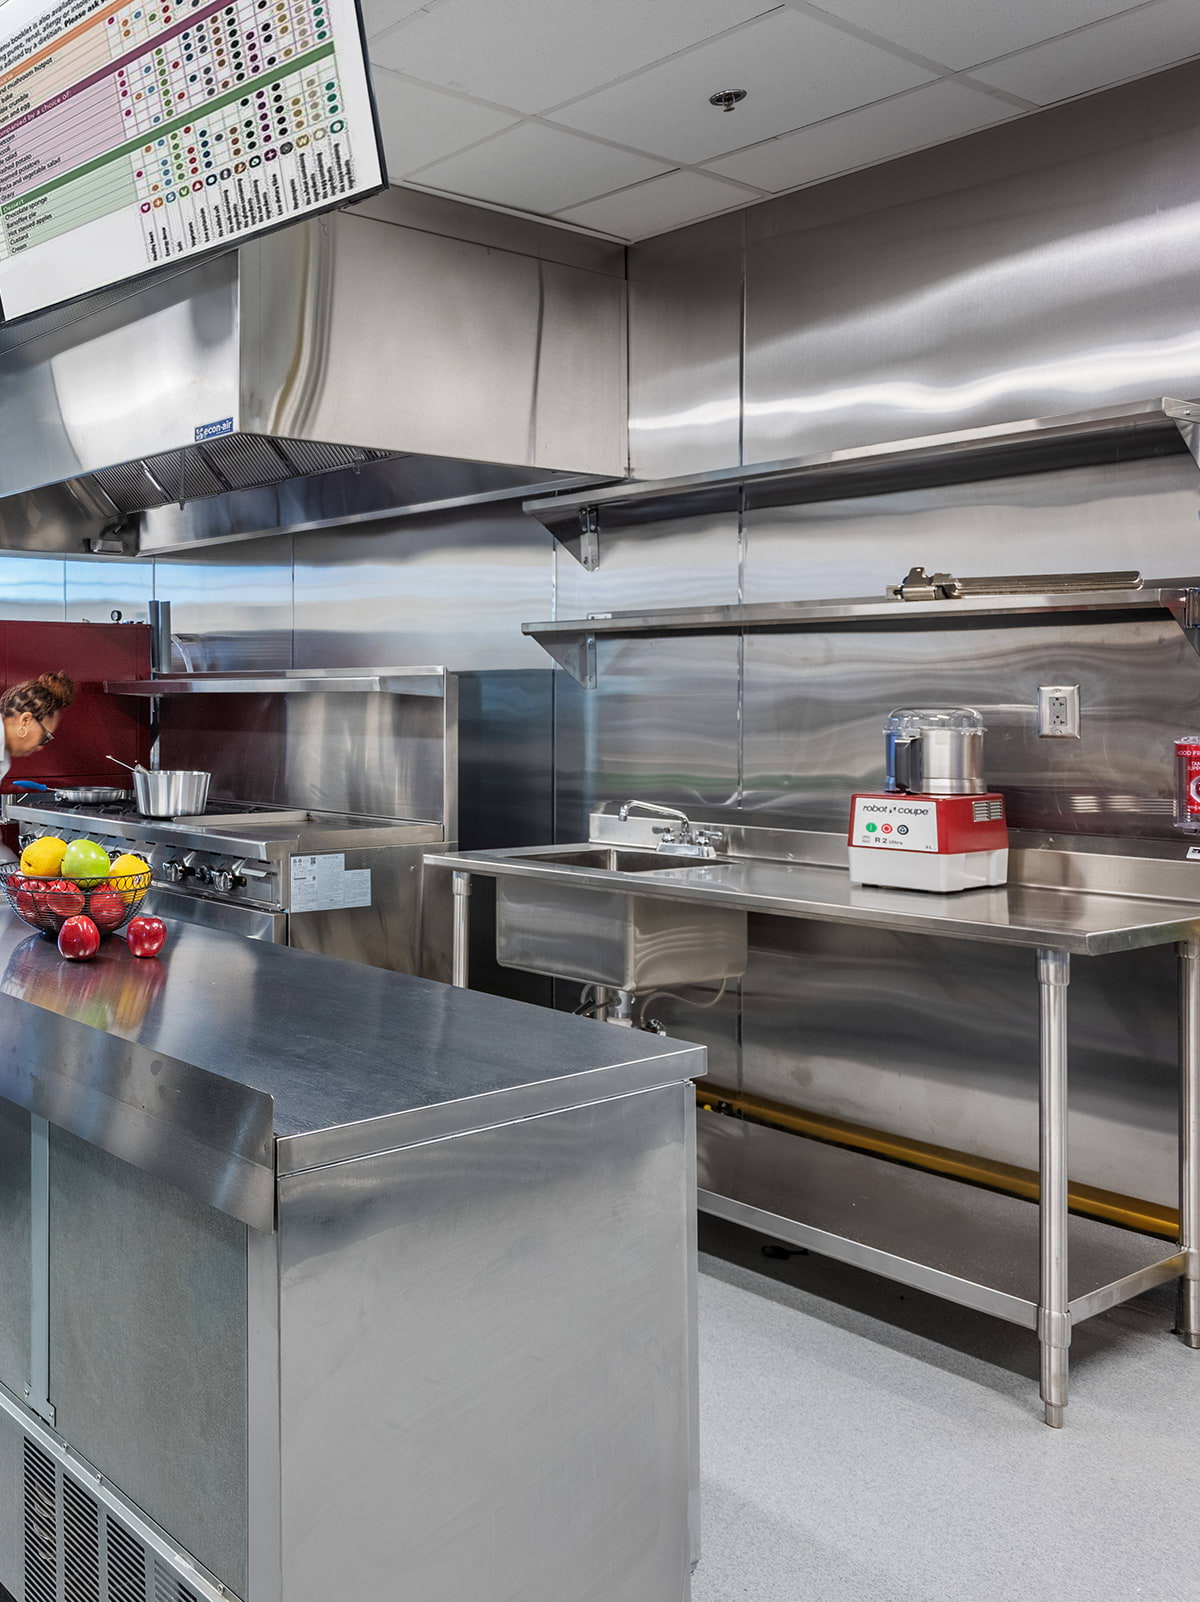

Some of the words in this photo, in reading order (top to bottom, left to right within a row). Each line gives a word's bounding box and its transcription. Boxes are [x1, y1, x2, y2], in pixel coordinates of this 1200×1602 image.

[4, 50, 25, 69] advised
[25, 45, 32, 55] by
[33, 41, 37, 50] a
[38, 24, 63, 46] dietitian.
[65, 9, 86, 29] Please
[87, 1, 99, 14] ask
[11, 26, 32, 45] booklet
[33, 21, 38, 30] is
[39, 13, 50, 26] also
[26, 29, 41, 45] renal,
[43, 15, 62, 34] allergy
[63, 10, 70, 20] or
[7, 69, 33, 90] mushroom
[34, 57, 52, 73] hotpot
[1, 93, 13, 104] bake
[9, 93, 29, 109] crumble
[10, 108, 19, 118] and
[20, 102, 30, 113] egg
[28, 112, 35, 121] by
[36, 108, 40, 116] a
[41, 97, 60, 113] choice
[5, 152, 17, 162] salad
[15, 153, 32, 167] potato
[0, 183, 11, 192] Pasta
[12, 177, 22, 186] and
[23, 165, 46, 182] vegetable
[47, 157, 61, 168] salad
[19, 159, 40, 175] potatoes
[1, 191, 15, 202] Gravy
[3, 199, 24, 213] Dessert
[5, 206, 28, 220] Chocolate
[29, 197, 47, 210] sponge
[18, 221, 35, 233] stewed
[36, 214, 52, 225] apples
[10, 233, 29, 245] Custard
[12, 243, 27, 253] Cream
[863, 804, 888, 813] robot
[898, 807, 929, 816] coupe
